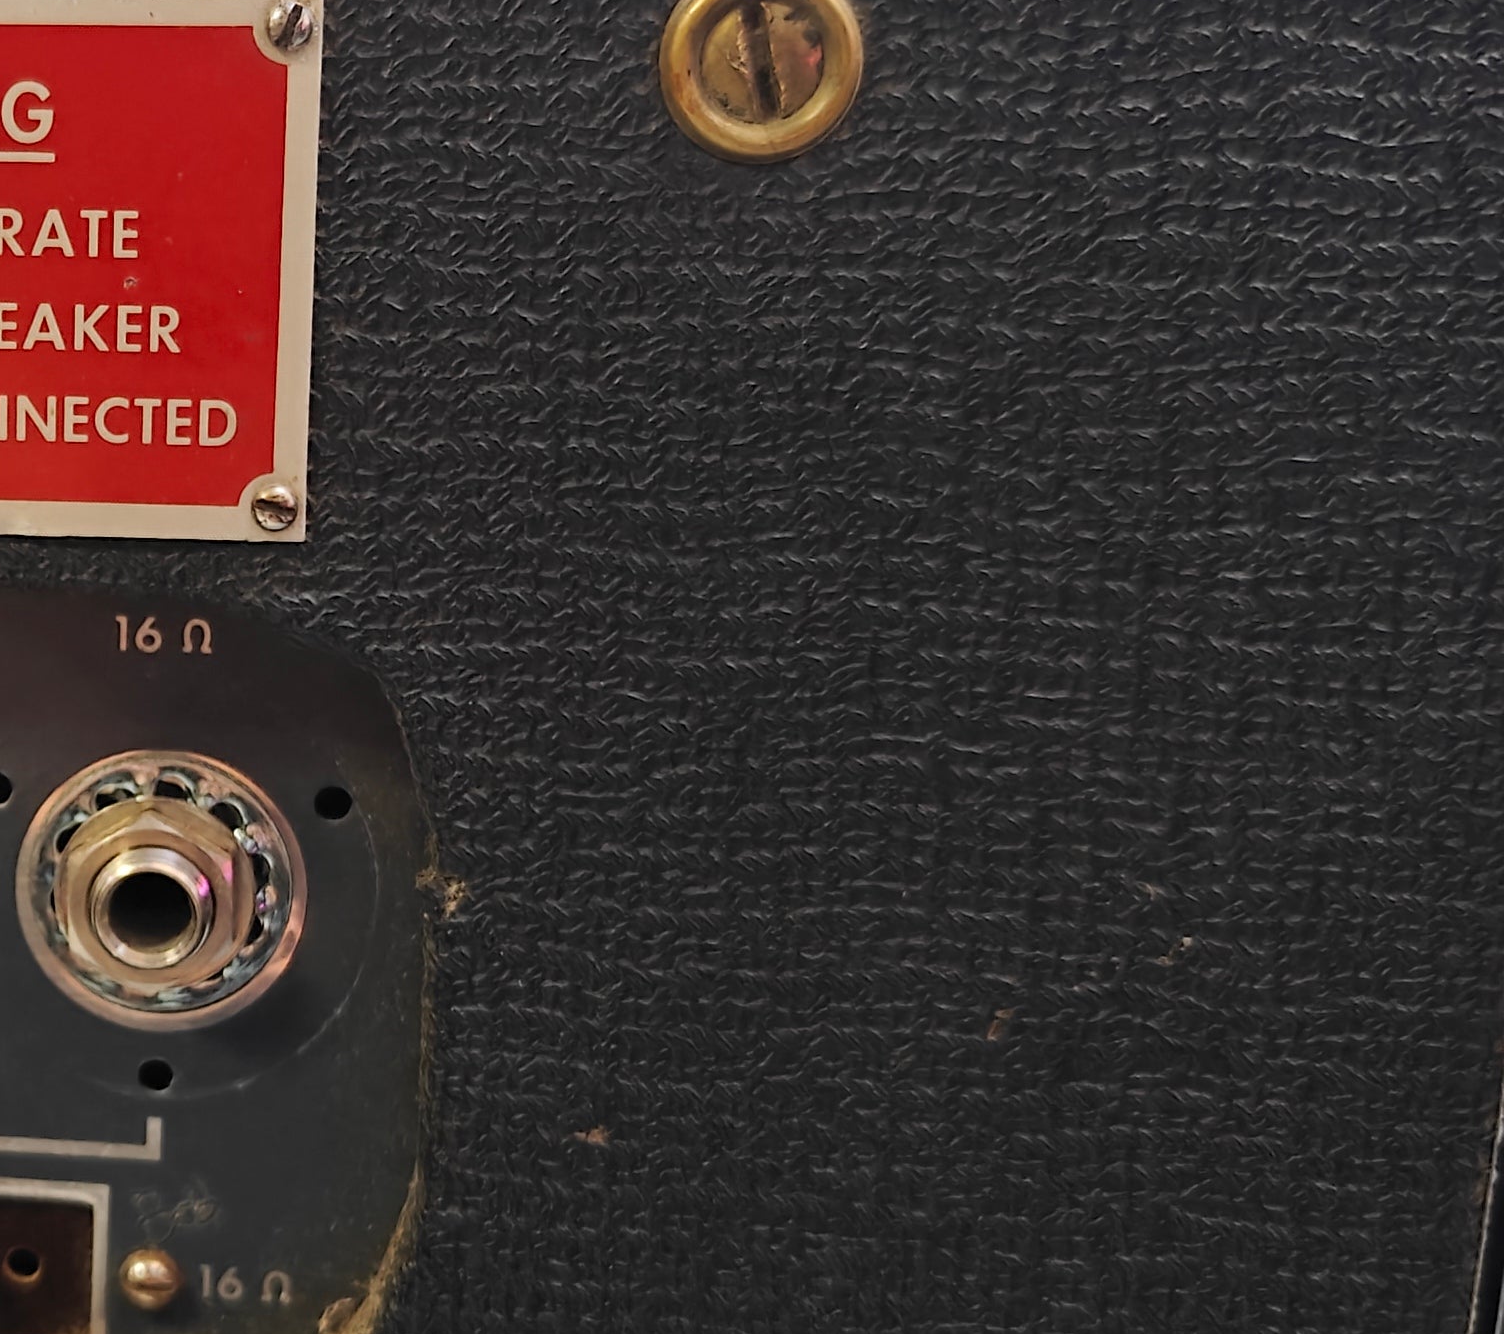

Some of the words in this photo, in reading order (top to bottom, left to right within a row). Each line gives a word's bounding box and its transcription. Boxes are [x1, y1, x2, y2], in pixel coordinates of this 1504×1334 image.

[115, 616, 163, 654] 16
[181, 619, 212, 655] Ω
[200, 1265, 246, 1303] 16
[261, 1271, 291, 1304] Ω
